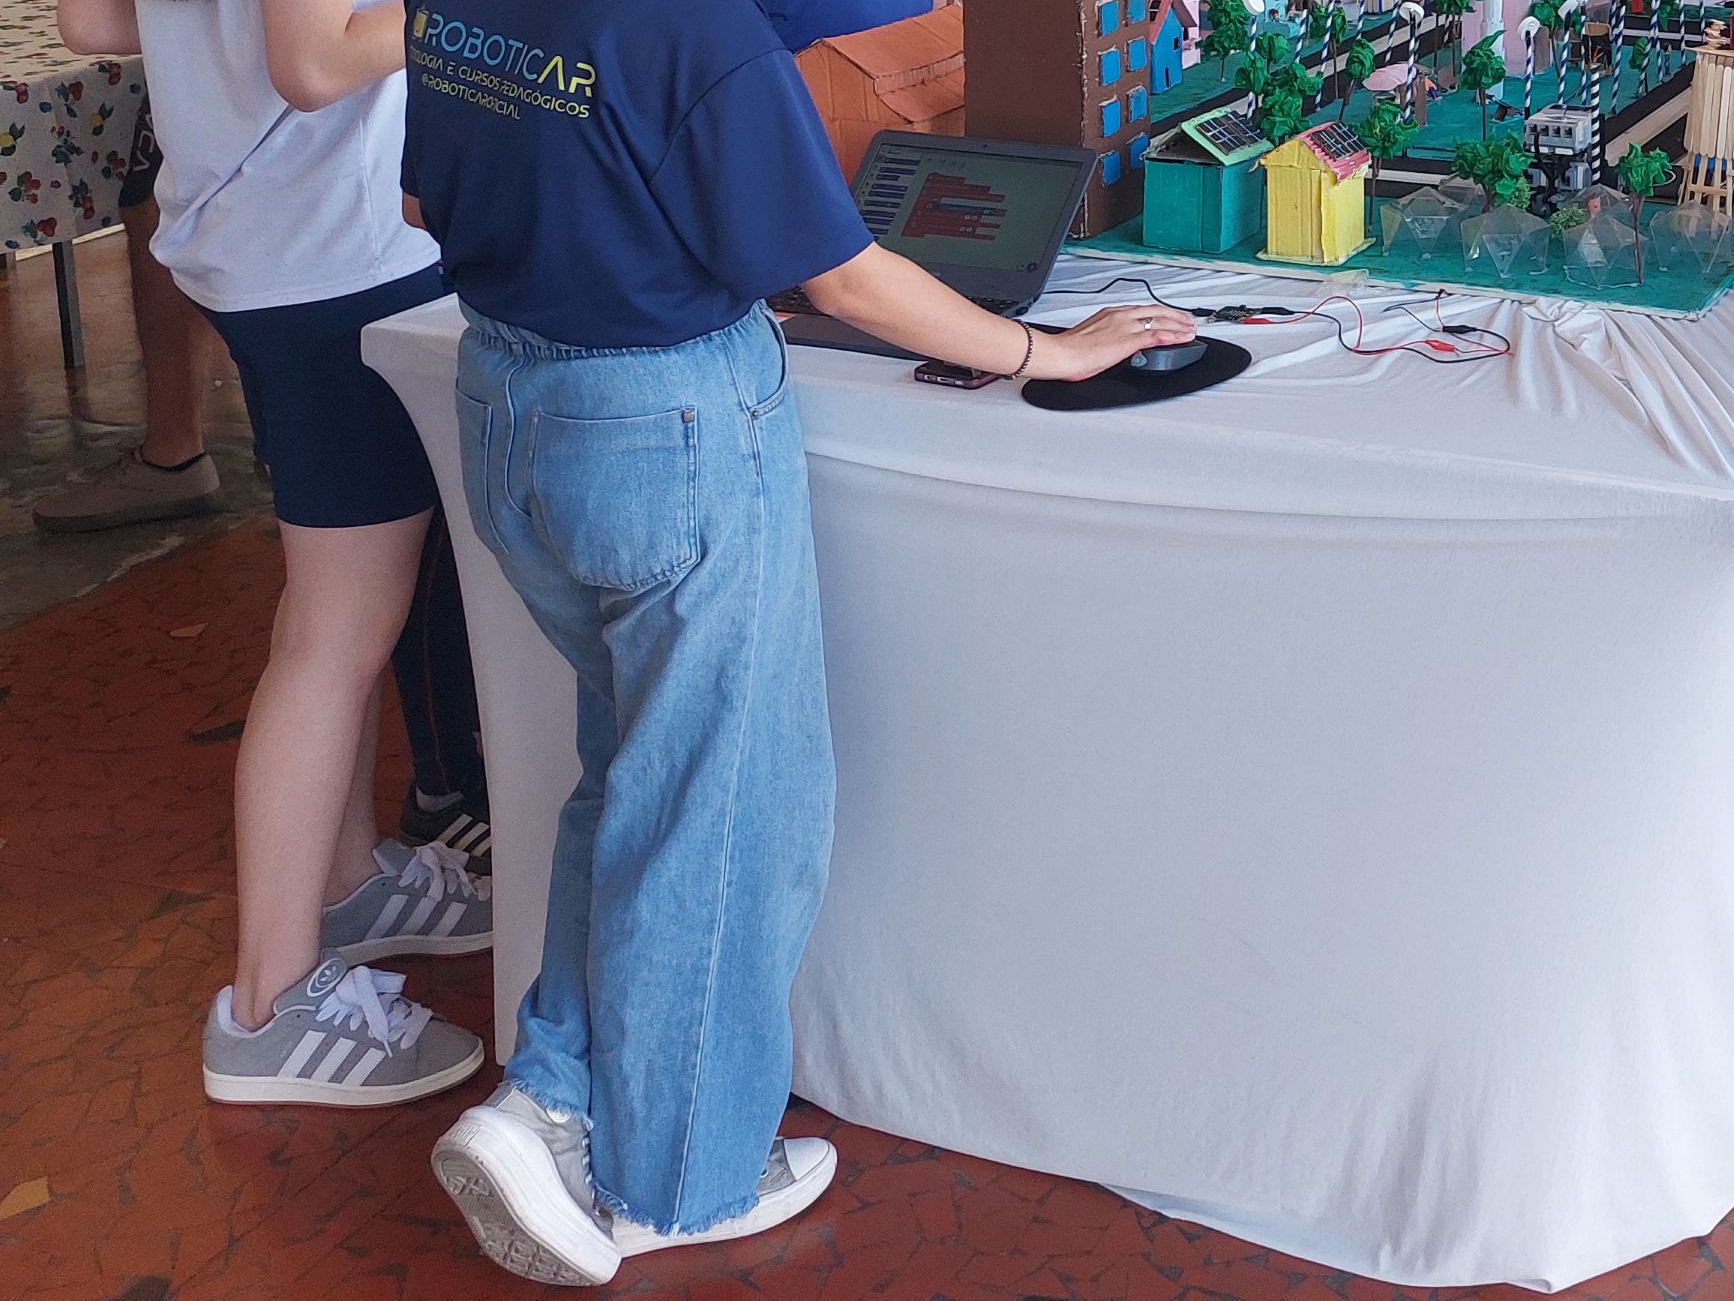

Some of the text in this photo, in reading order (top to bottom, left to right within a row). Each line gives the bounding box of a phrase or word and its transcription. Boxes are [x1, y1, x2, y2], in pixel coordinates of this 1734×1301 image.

[424, 12, 597, 98] ROBOTICAR
[446, 61, 457, 76] E
[458, 66, 501, 93] CURSOS
[499, 80, 591, 118] PEDAGÓGICOS
